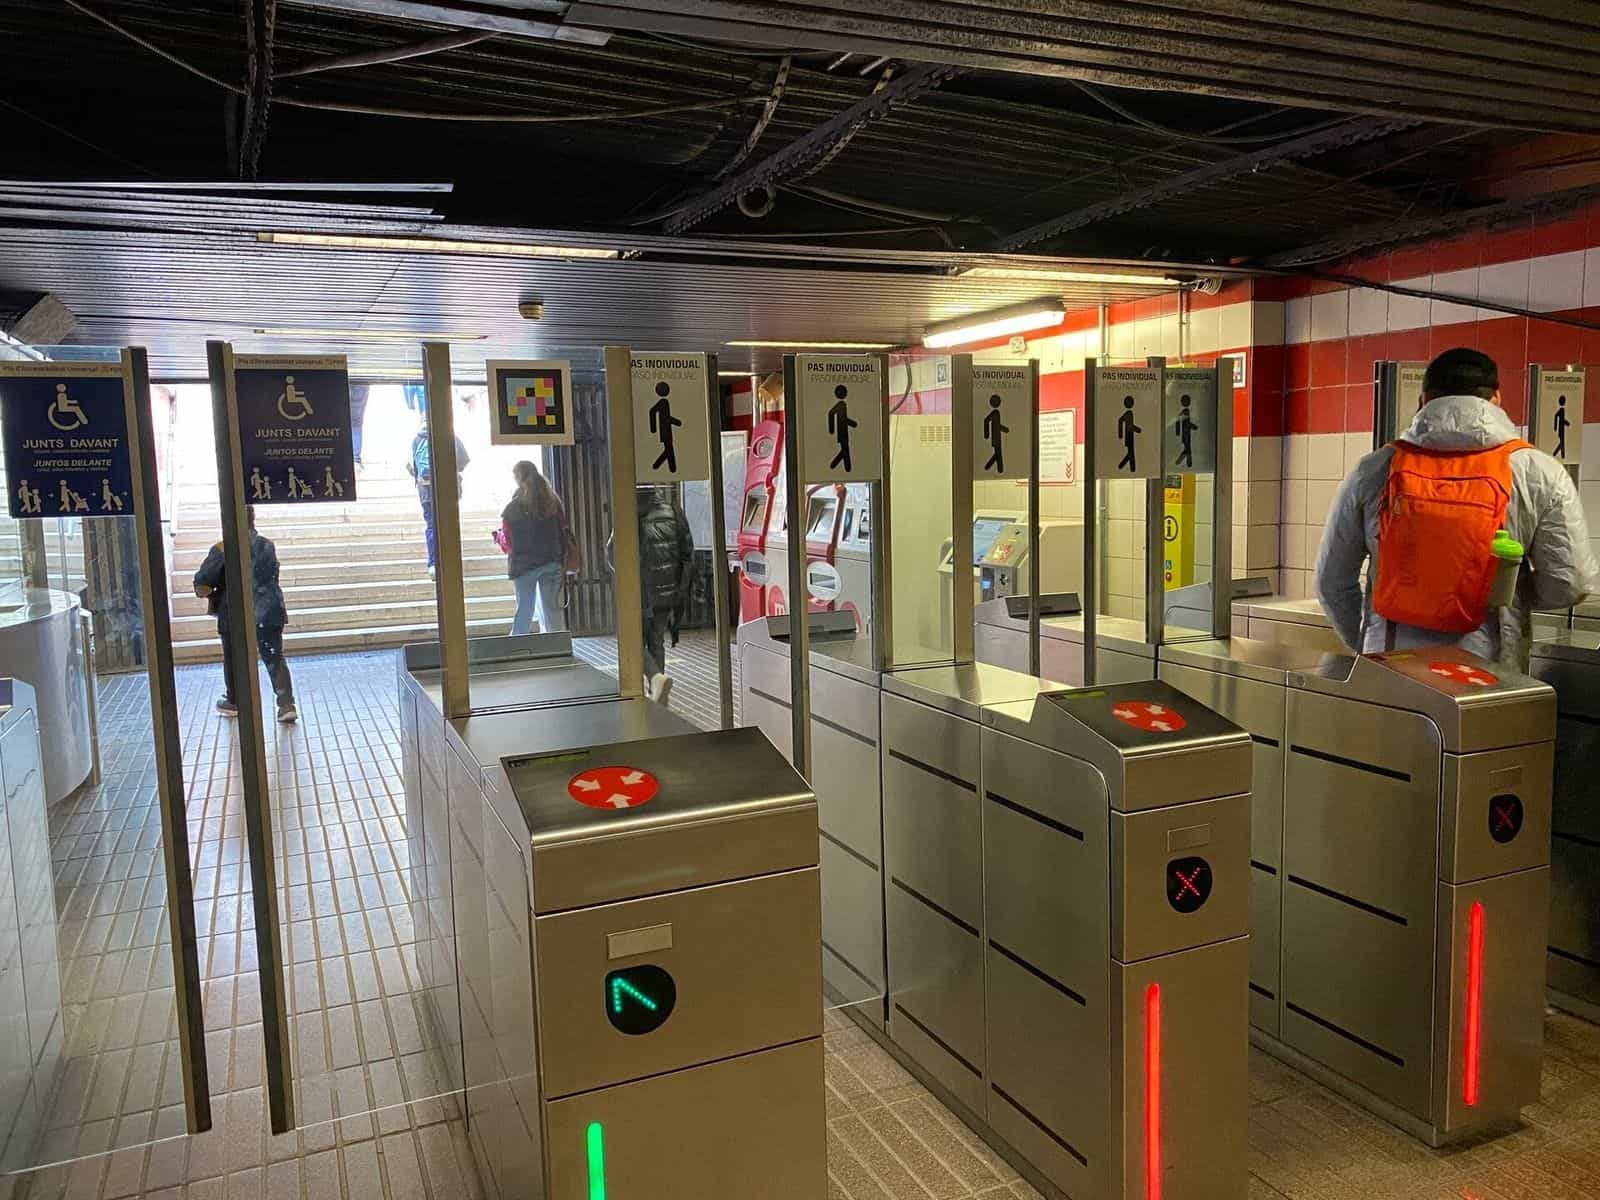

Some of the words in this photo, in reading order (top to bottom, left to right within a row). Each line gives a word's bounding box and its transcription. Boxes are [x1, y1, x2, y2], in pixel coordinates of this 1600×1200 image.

[631, 359, 643, 368] AS
[645, 359, 701, 369] INDIVIDUAL
[807, 363, 824, 372] PAS
[826, 363, 875, 373] INDIVIDUAL
[982, 370, 1025, 379] INDIVIDUAL
[1102, 372, 1116, 380] PAS
[1117, 372, 1158, 381] INDIVIDUAL
[255, 428, 292, 438] JUNTS
[297, 427, 341, 437] DAVANT
[22, 439, 65, 449] JUNTS
[70, 438, 119, 448] DAVANT
[263, 447, 297, 456] JUNTOS
[298, 447, 336, 455] DELANTE
[33, 459, 69, 468] JUNTOS
[71, 459, 113, 467] DELANTE
